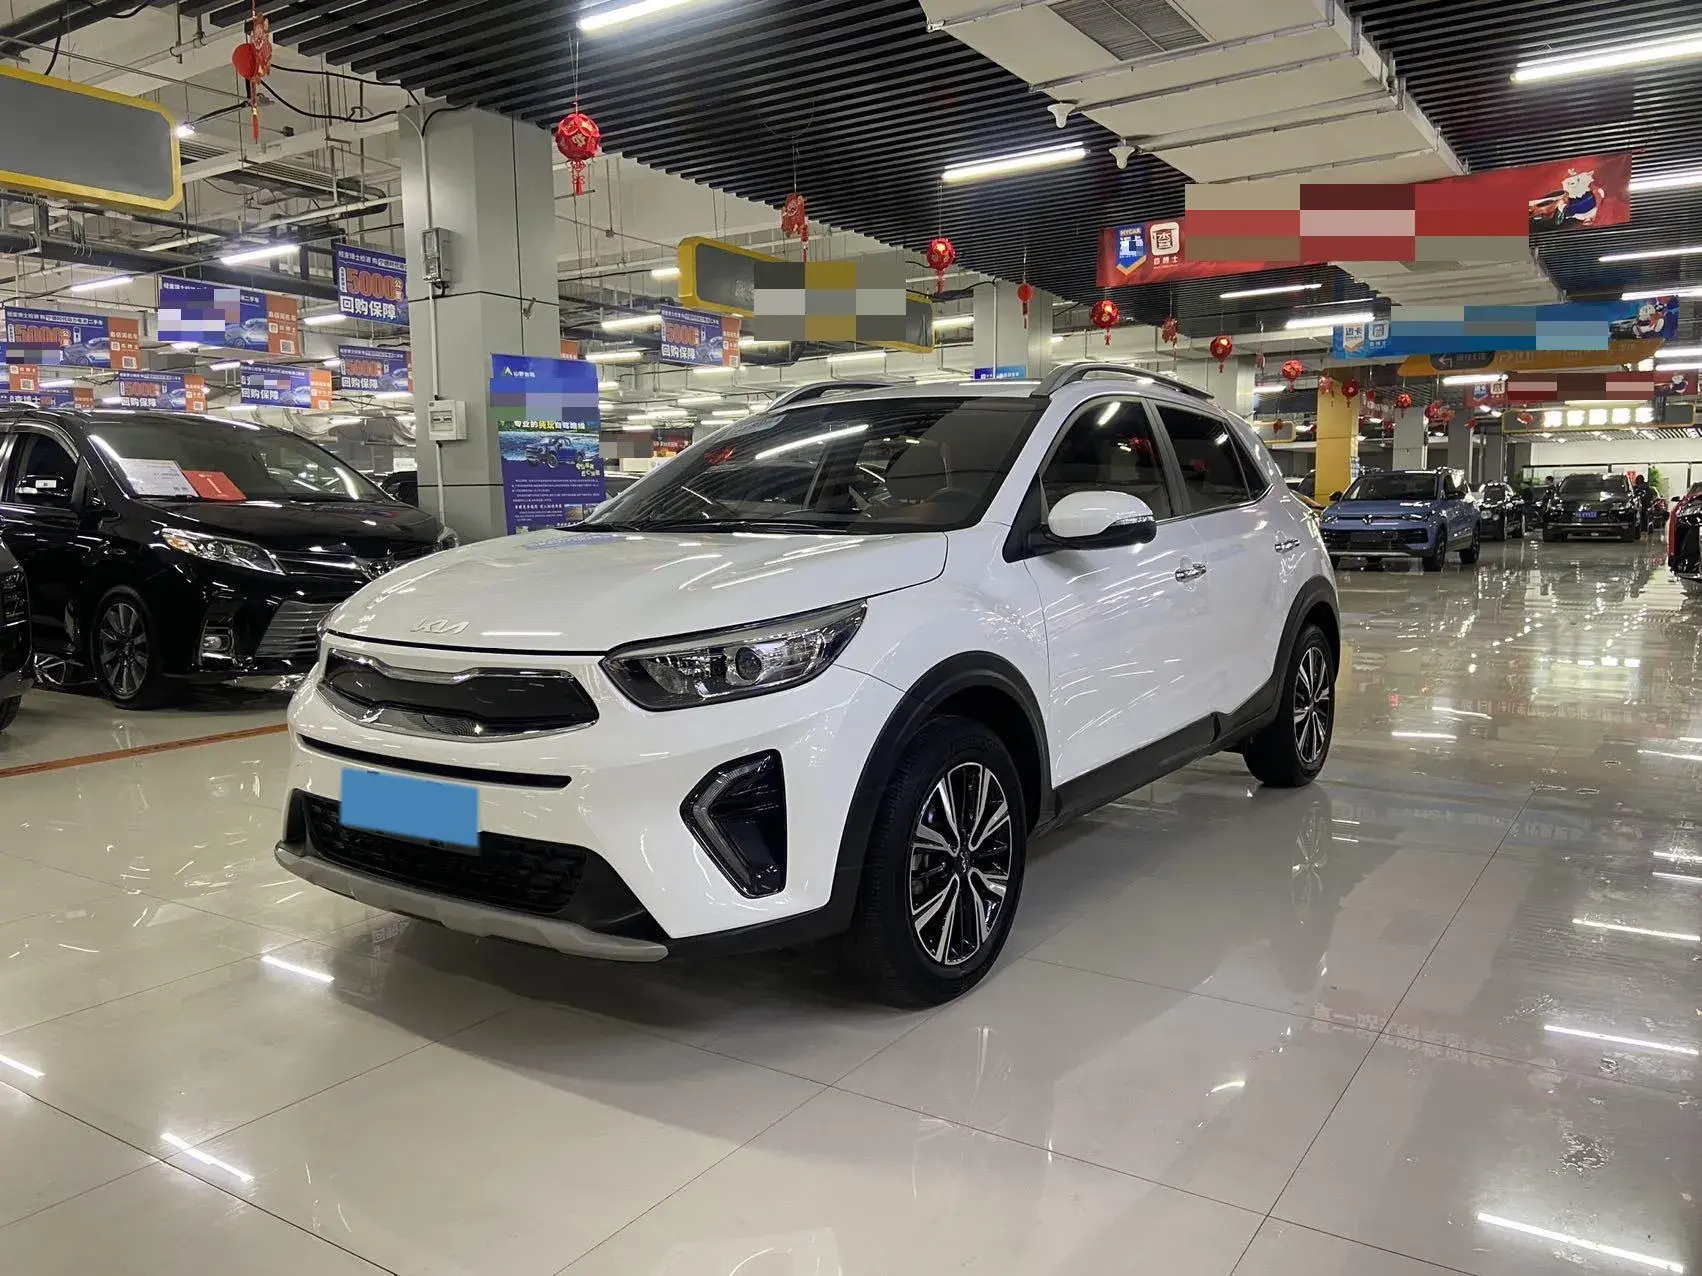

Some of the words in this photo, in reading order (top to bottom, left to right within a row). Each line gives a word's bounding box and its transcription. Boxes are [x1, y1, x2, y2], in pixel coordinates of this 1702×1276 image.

[346, 267, 396, 300] 5000
[340, 295, 397, 320] 回购保障
[662, 343, 696, 361] 回购保障
[341, 377, 378, 390] 回购保障
[241, 388, 279, 401] 回购保障
[408, 616, 469, 635] KIA
